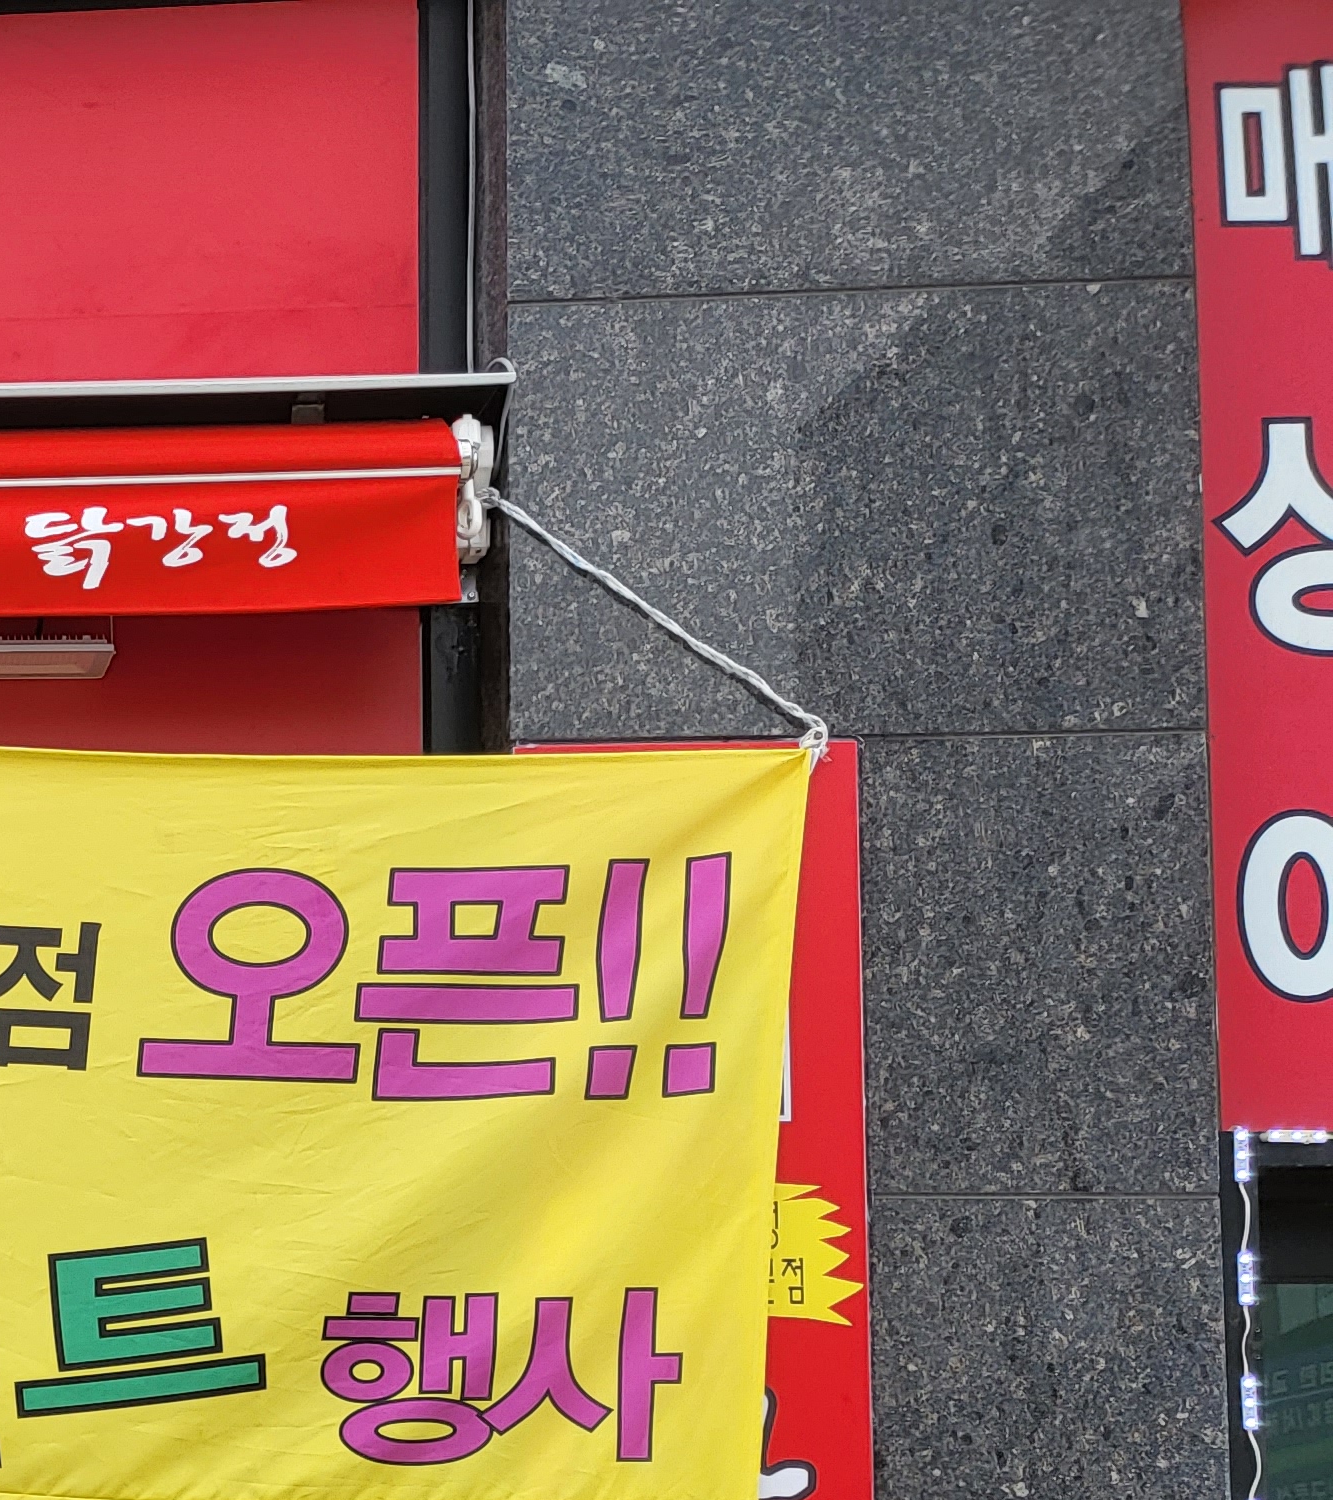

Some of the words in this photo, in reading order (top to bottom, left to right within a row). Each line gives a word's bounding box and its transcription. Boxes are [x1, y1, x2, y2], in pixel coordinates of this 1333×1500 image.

[24, 505, 297, 589] 닭강정
[137, 851, 734, 1102] 오픈!!
[319, 1285, 684, 1466] 행사
